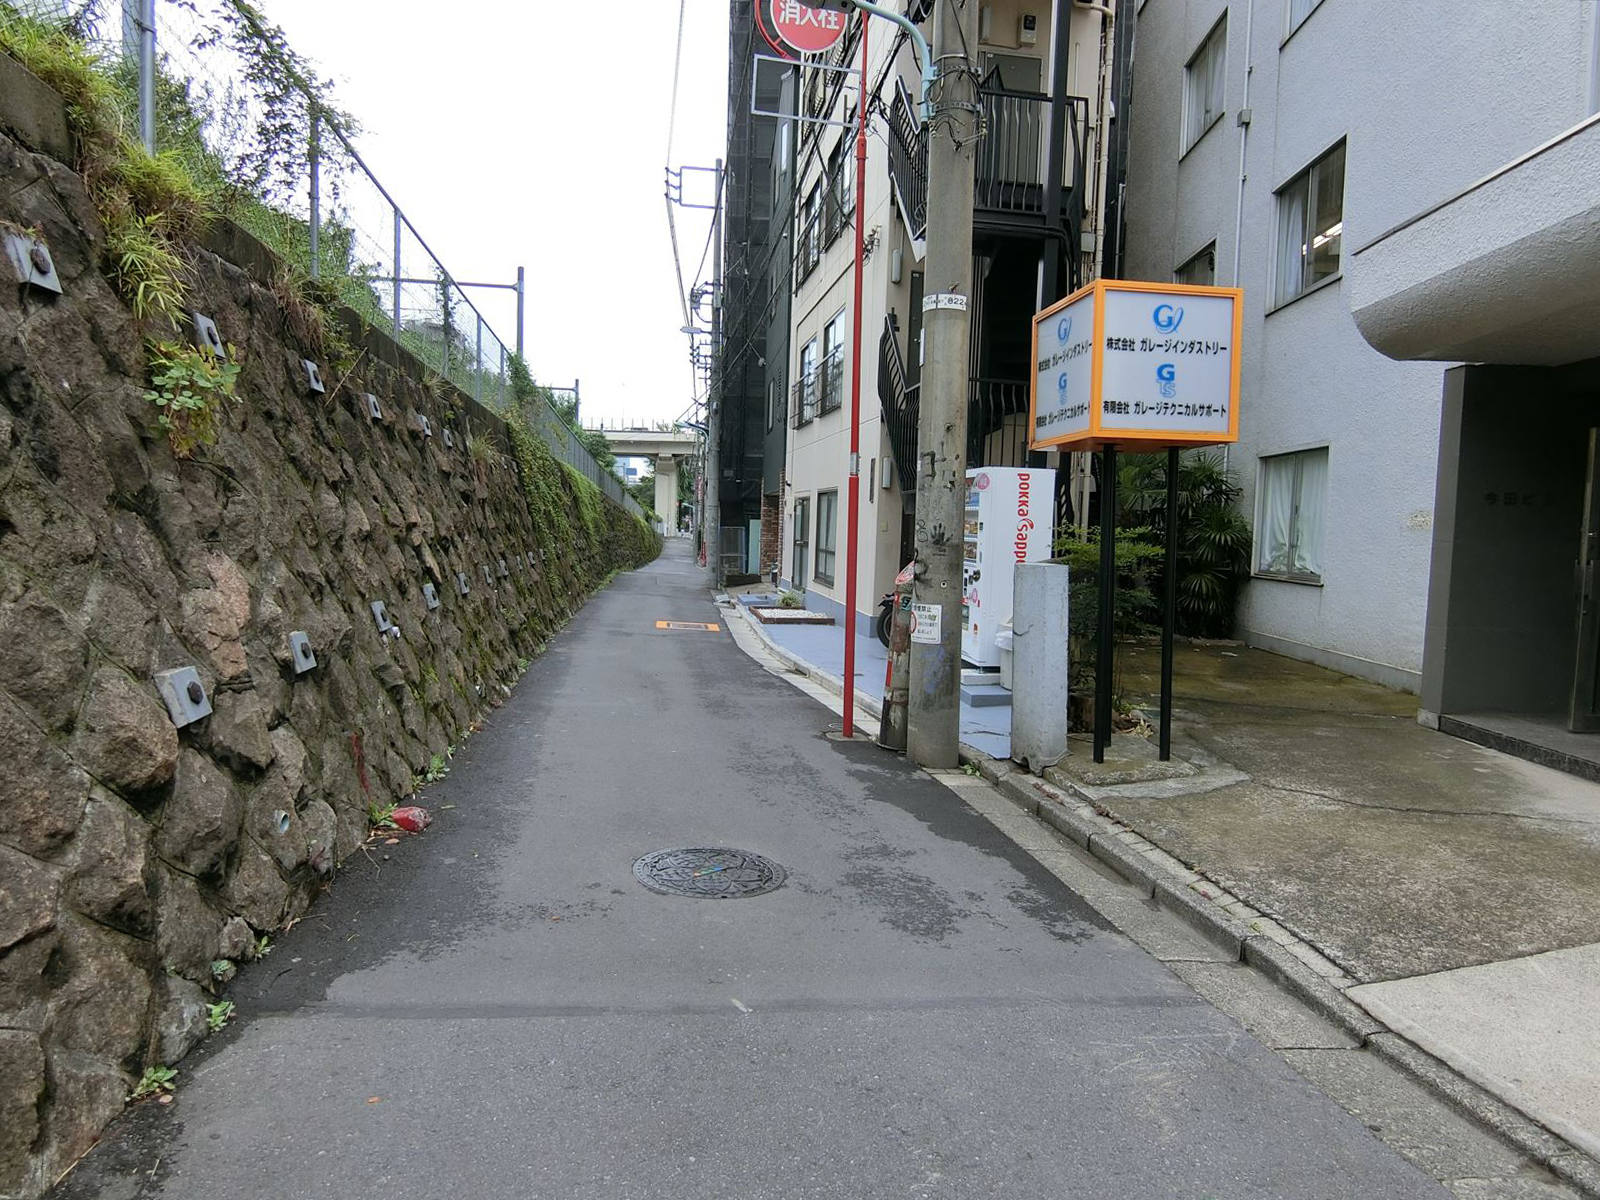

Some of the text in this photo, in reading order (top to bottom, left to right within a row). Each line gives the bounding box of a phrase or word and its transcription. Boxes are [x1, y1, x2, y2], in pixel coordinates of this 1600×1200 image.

[1106, 337, 1227, 355] 株式会社 ガレージインダストリー
[1103, 400, 1227, 418] 有限会社 ガレージテクニカルサポート
